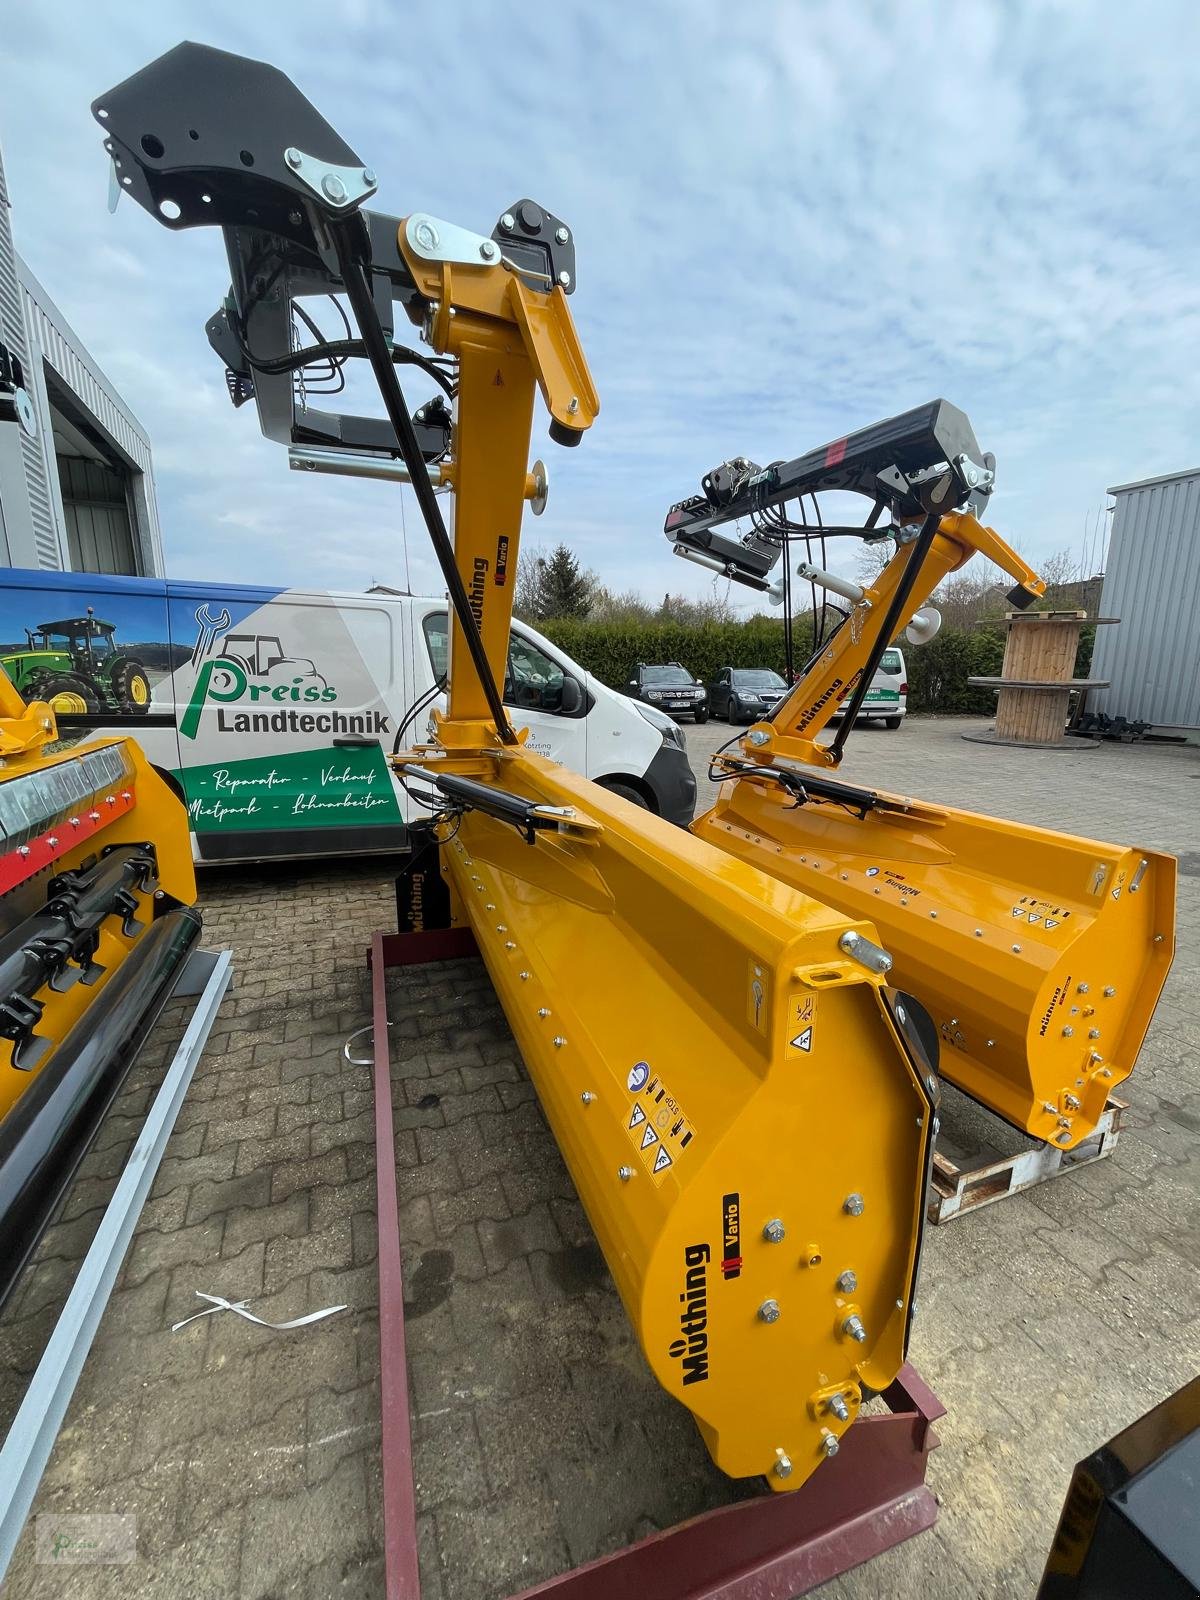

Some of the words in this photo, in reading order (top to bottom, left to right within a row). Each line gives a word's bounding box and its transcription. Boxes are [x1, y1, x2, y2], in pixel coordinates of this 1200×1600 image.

[497, 542, 508, 567] Vario
[179, 660, 338, 740] Preiss
[217, 708, 390, 734] Landtechnik
[794, 678, 844, 732] Müthing
[213, 769, 291, 795] Reparatur
[321, 765, 377, 787] Verkauf
[188, 797, 262, 823] Mietpark
[291, 791, 390, 815] Lohnarbeiten
[407, 873, 425, 932] Müthing
[1039, 987, 1061, 1036] Müthing
[665, 1097, 679, 1116] STOP
[726, 1203, 738, 1247] Vario
[669, 1243, 711, 1386] Müthing
